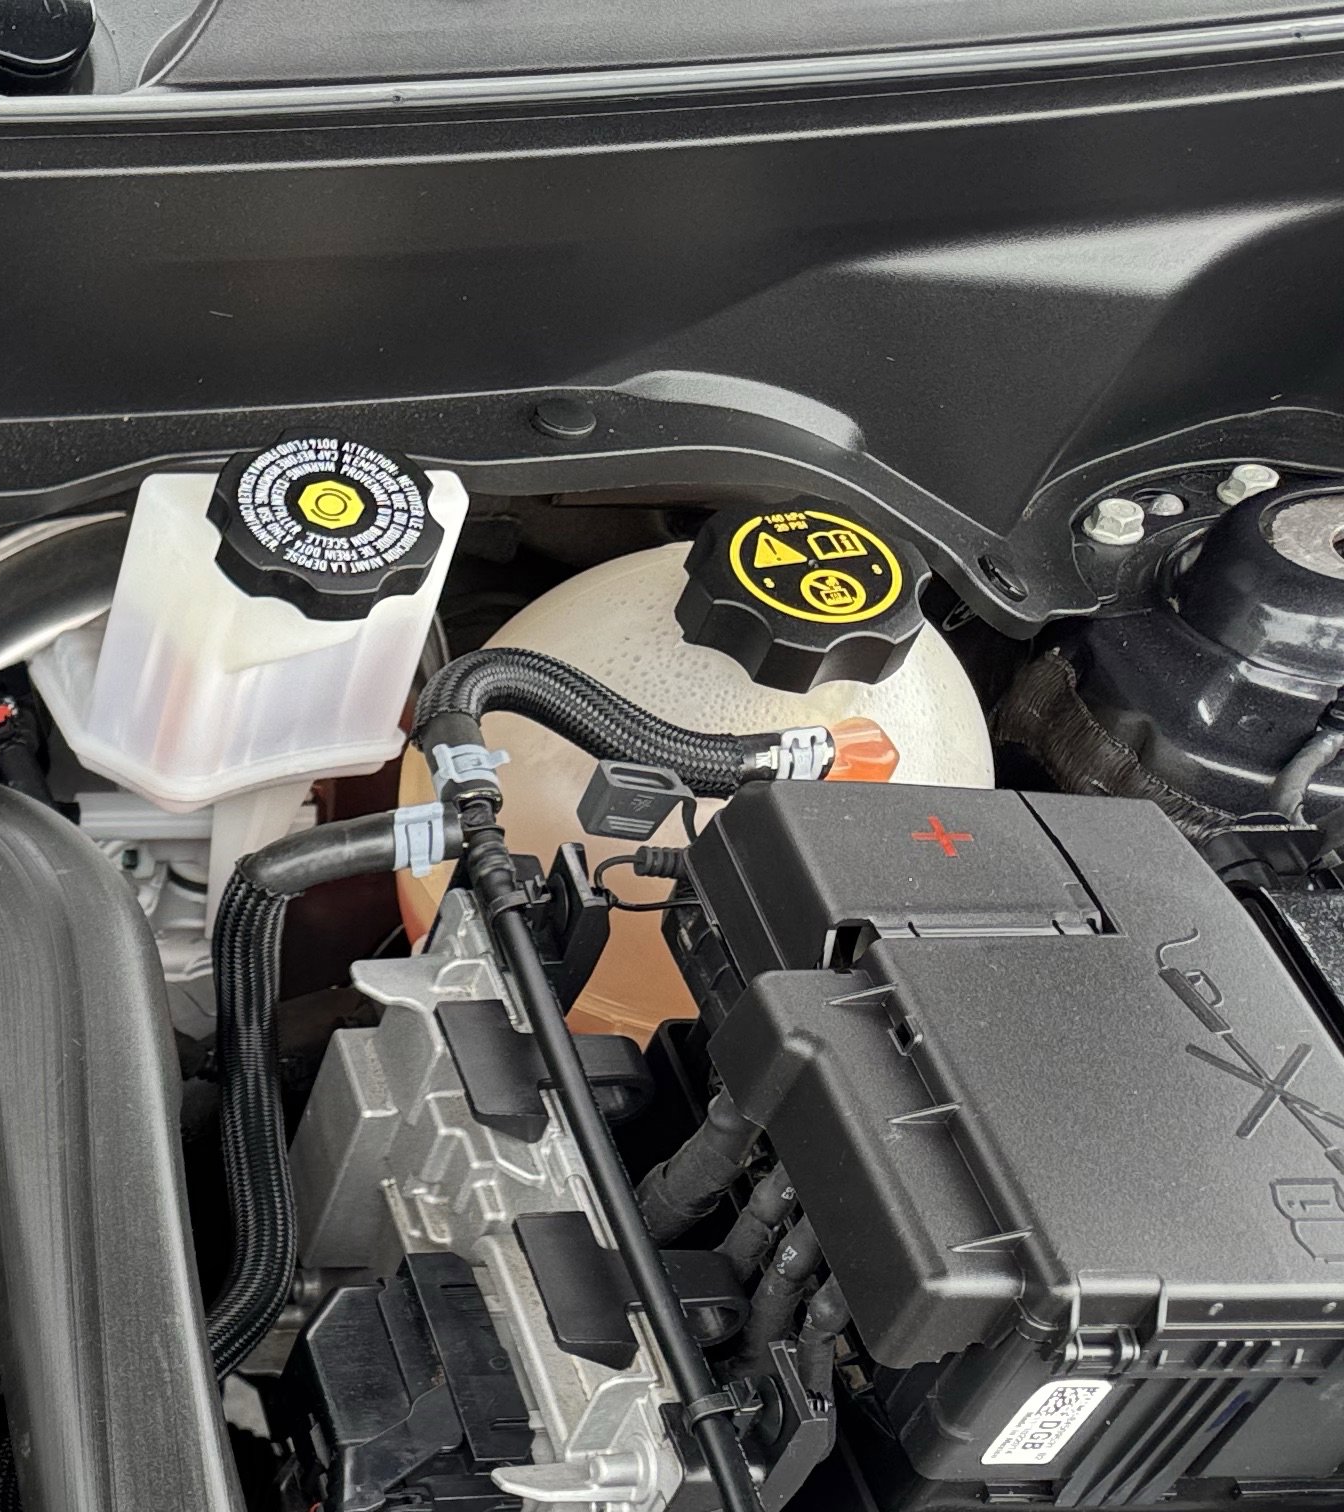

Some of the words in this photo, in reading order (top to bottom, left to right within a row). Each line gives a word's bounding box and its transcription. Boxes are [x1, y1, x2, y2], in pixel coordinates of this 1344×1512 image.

[274, 439, 309, 456] FLUID
[287, 449, 317, 465] BEFORE
[314, 449, 339, 461] CAP
[249, 447, 282, 470] FROM
[341, 441, 402, 476] ATTENTION:
[245, 465, 261, 476] A
[280, 461, 336, 482] WARNING:
[342, 453, 401, 493] N'EMPLOYER
[238, 471, 258, 503] SEALED
[270, 477, 291, 504] CLEAN
[339, 463, 391, 505] PROVENANT
[390, 492, 407, 510] QUE
[395, 474, 423, 516] NETTOYER
[257, 506, 273, 522] USE
[270, 505, 304, 535] FILLER
[373, 507, 392, 528] D'UN
[392, 511, 407, 525] DU
[408, 517, 424, 530] LE
[263, 521, 294, 544] ONLY
[349, 525, 384, 548] BIDON
[371, 523, 404, 552] LIQUIDE
[324, 549, 359, 561] FREIN
[356, 544, 377, 558] DE
[381, 528, 421, 563] BOUCHON
[329, 562, 347, 572] LA
[349, 556, 385, 573] AVANT
[1021, 1420, 1062, 1450] DGB
